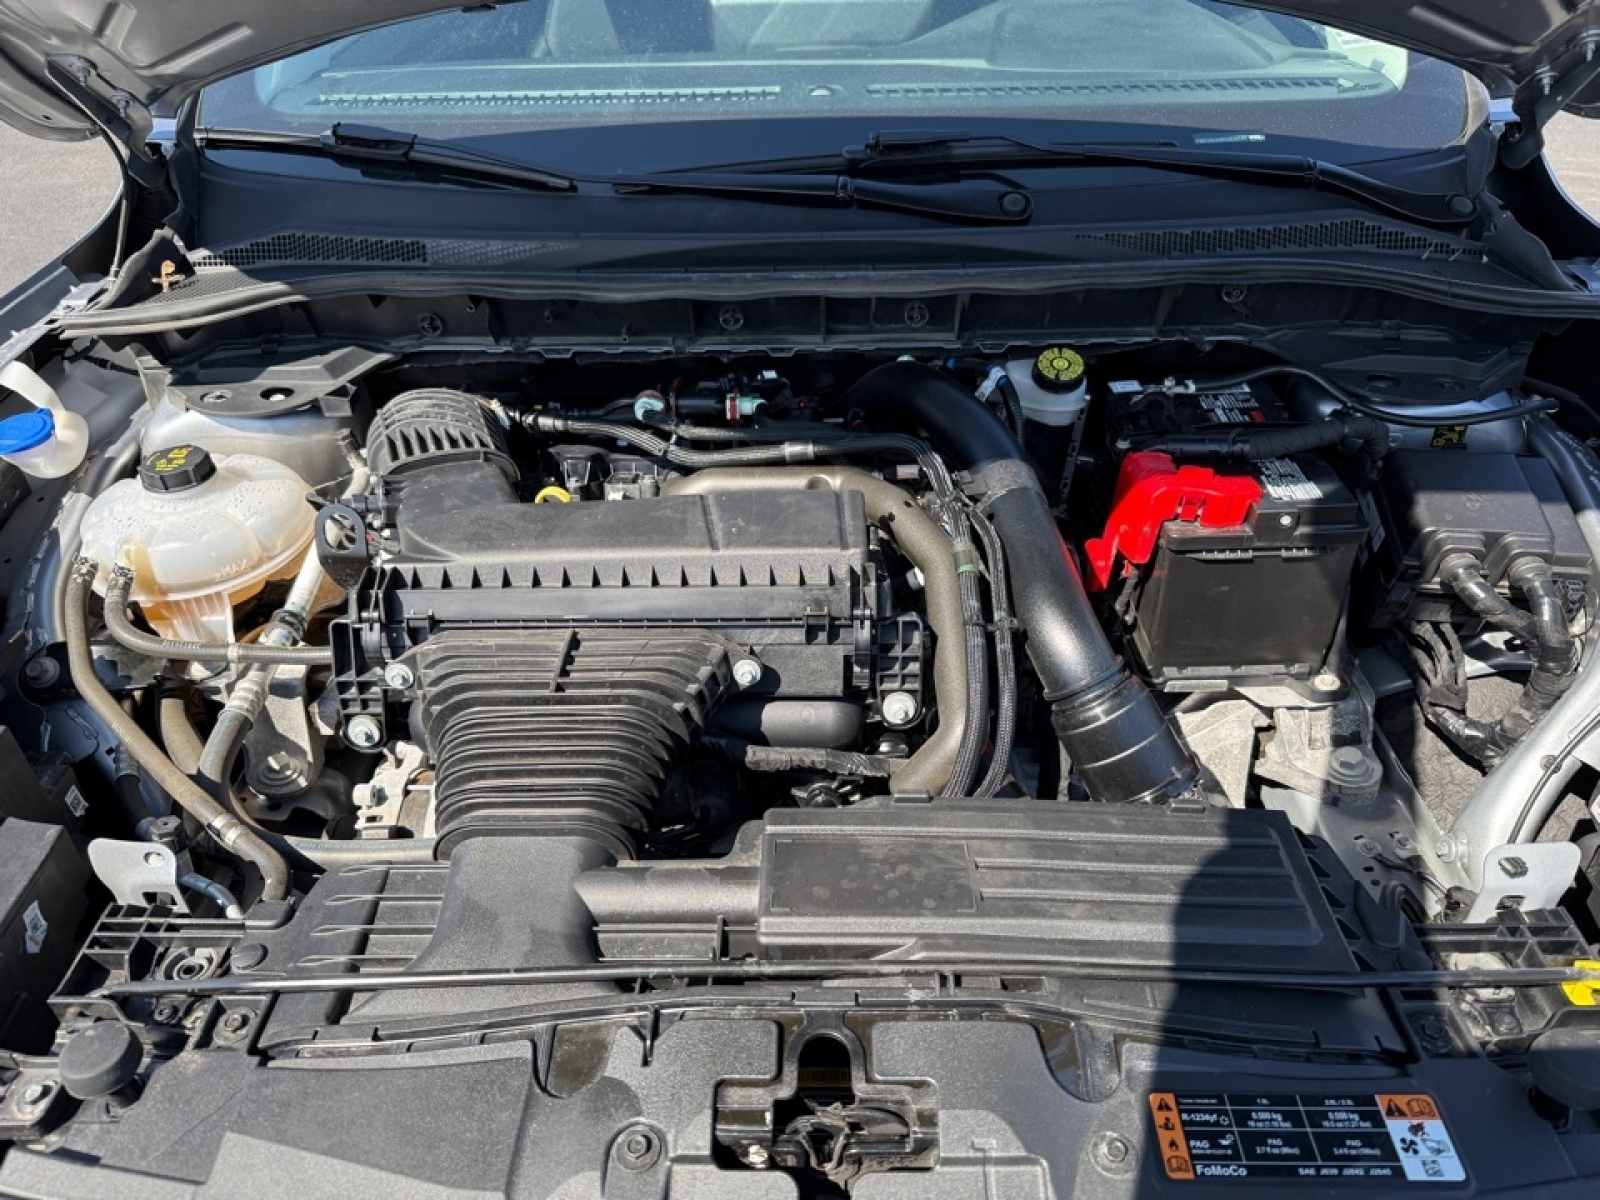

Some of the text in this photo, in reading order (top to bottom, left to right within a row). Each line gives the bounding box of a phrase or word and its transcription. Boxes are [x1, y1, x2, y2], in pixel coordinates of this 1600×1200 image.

[1181, 1113, 1218, 1123] R-1234yf
[1271, 1112, 1282, 1121] kg
[1189, 1139, 1210, 1148] PAG
[1267, 1138, 1283, 1146] PAG
[1345, 1139, 1362, 1147] PAG
[1196, 1165, 1247, 1176] FoMoCo
